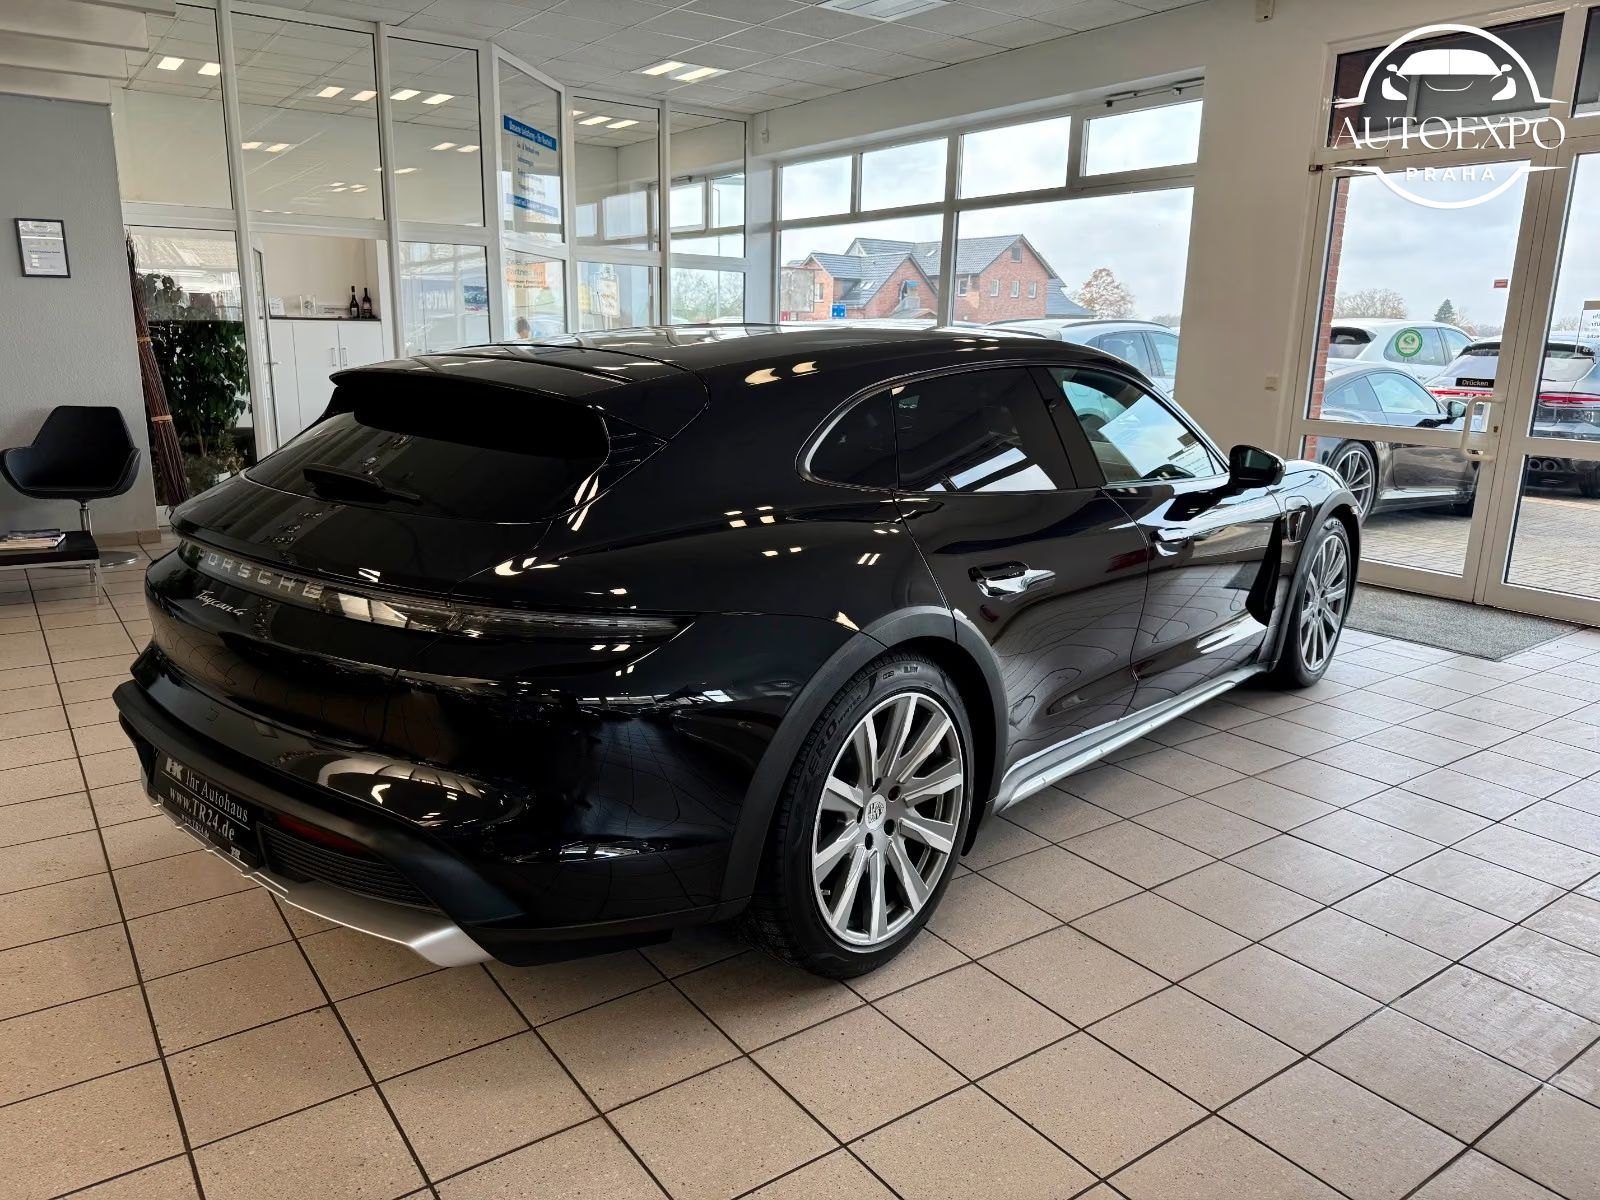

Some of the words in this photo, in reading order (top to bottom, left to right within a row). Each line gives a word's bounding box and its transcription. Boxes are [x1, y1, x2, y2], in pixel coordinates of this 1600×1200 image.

[1461, 379, 1489, 387] Drücken
[196, 546, 325, 600] PORSCHE
[195, 589, 234, 613] Taycan
[169, 787, 236, 841] www.TR24.de
[185, 769, 200, 791] Ihr
[201, 781, 249, 823] Autohaus
